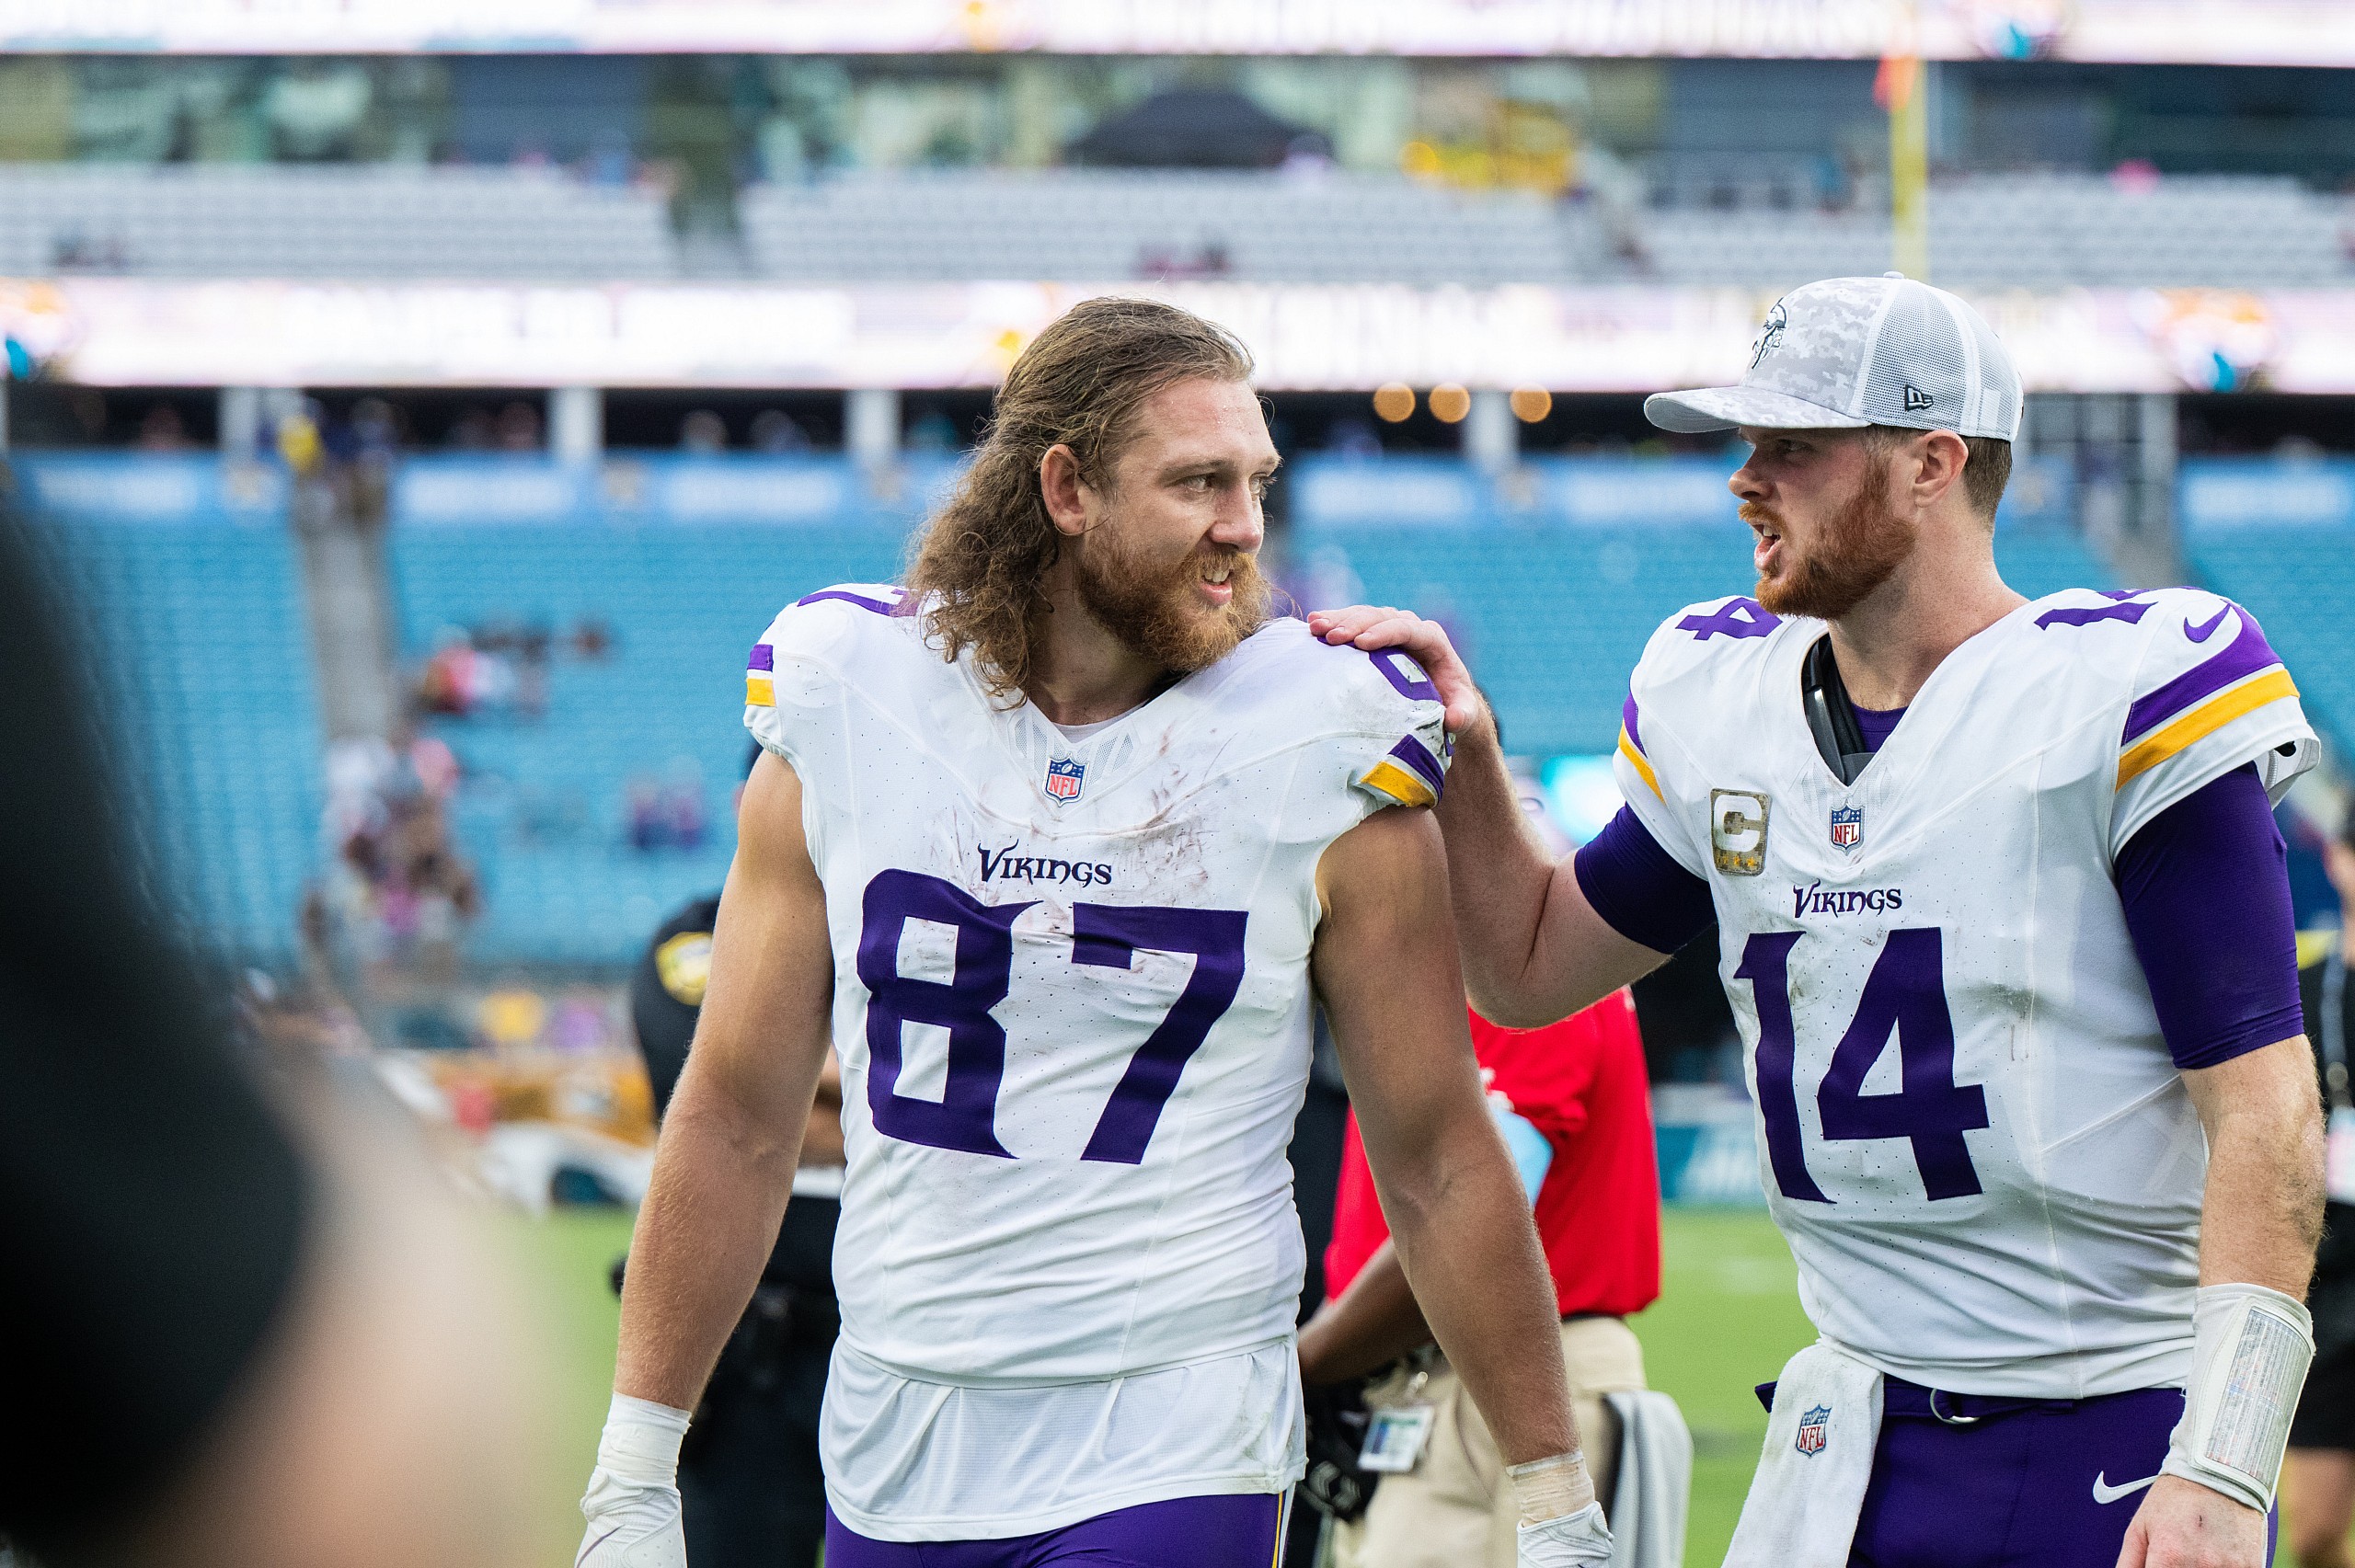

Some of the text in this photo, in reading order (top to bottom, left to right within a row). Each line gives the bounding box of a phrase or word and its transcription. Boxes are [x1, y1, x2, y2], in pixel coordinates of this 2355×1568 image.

[1048, 773, 1077, 797] NFL
[1714, 794, 1763, 853] C
[1833, 823, 1860, 845] NFL
[856, 868, 1249, 1165] 87
[1733, 926, 1990, 1205] 14
[1798, 1425, 1824, 1452] NFL
